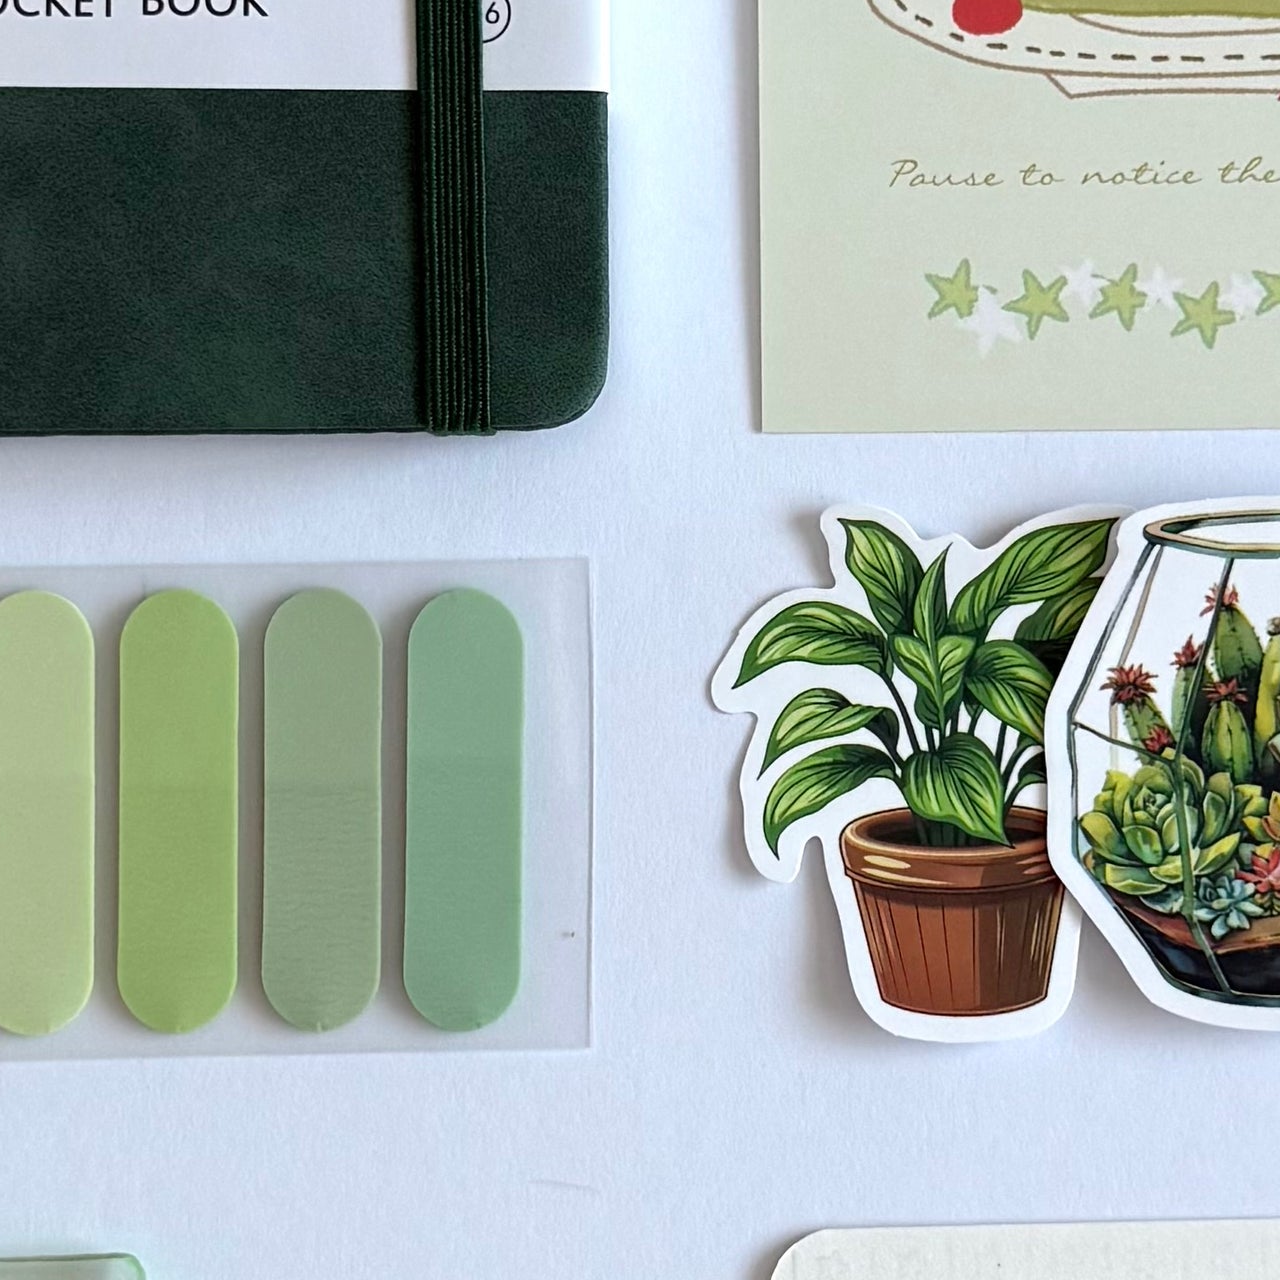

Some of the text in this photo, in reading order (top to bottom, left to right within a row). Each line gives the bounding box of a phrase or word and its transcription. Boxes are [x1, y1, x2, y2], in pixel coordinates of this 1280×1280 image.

[887, 159, 1004, 188] Pause
[1020, 163, 1066, 186] to
[1080, 160, 1203, 185] notice
